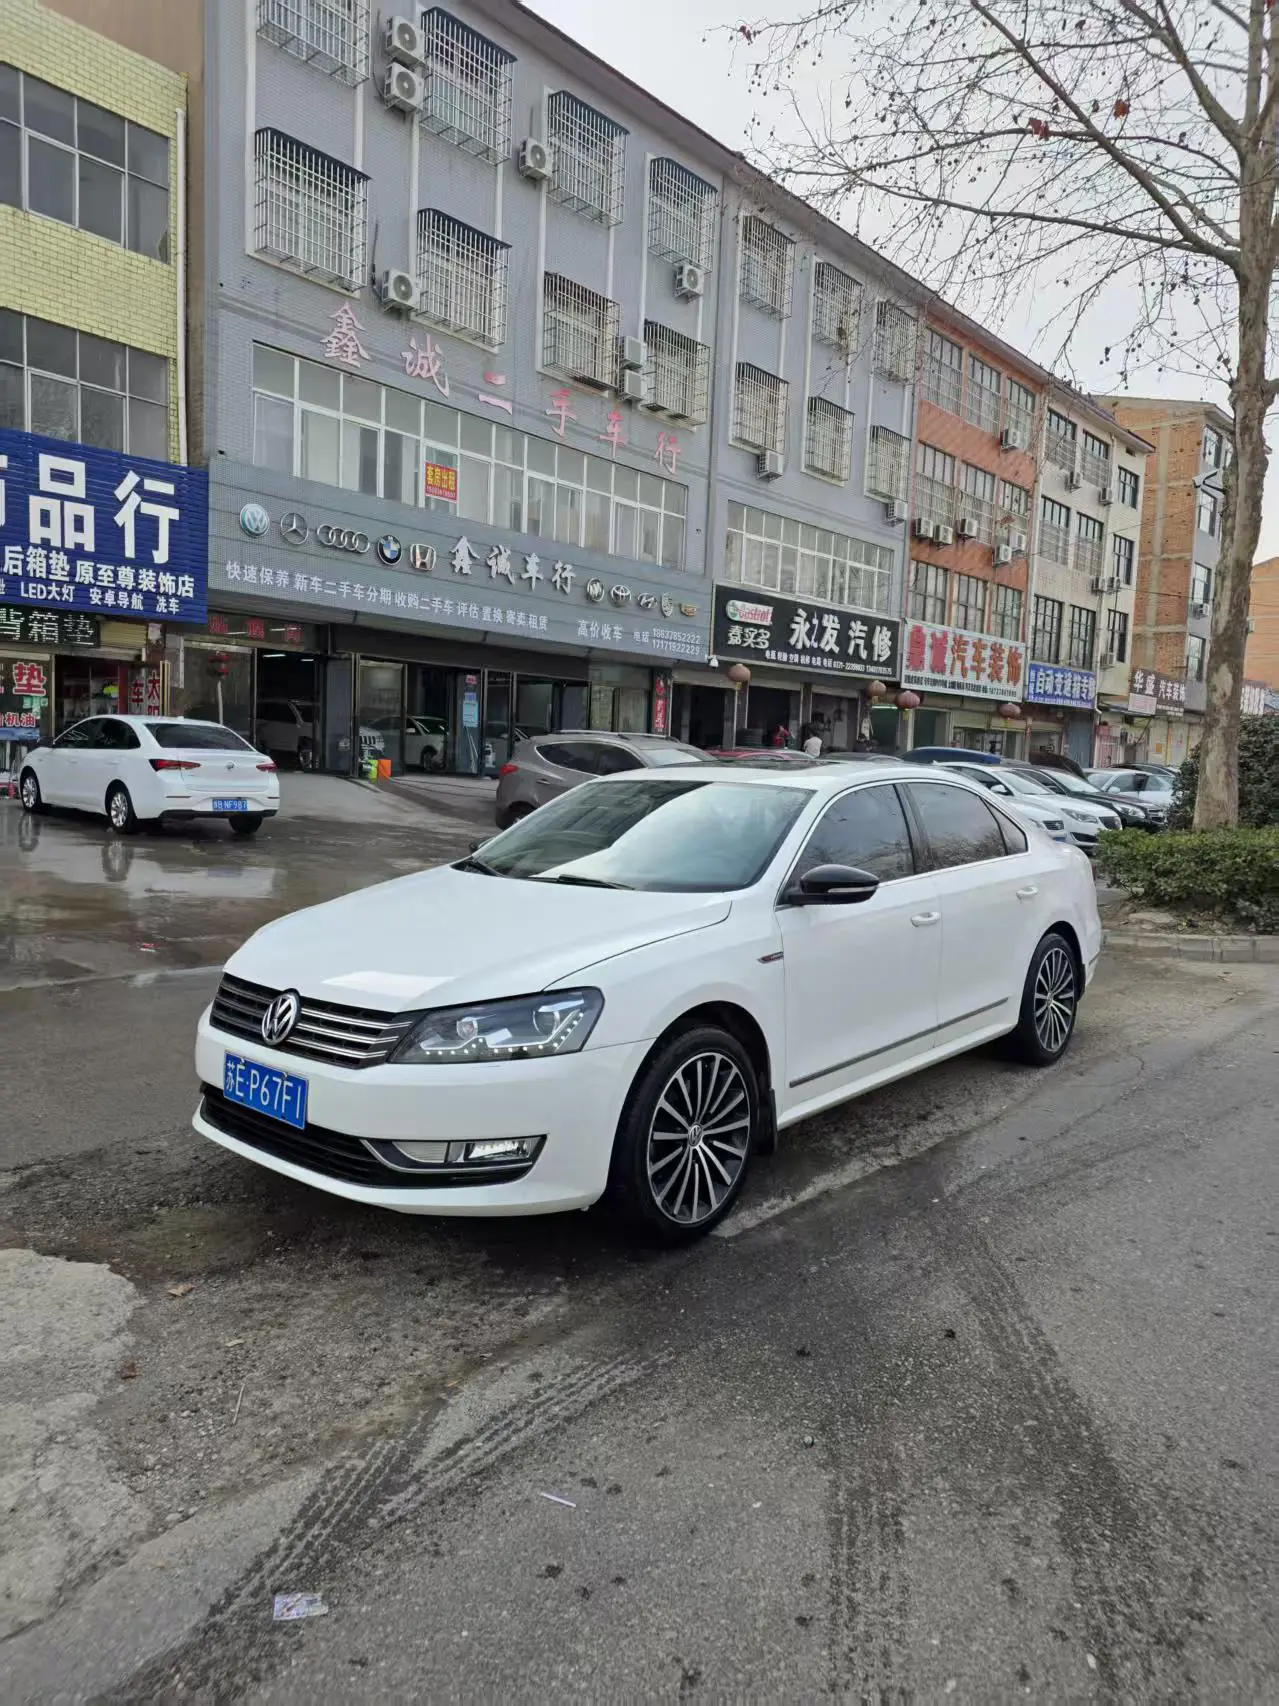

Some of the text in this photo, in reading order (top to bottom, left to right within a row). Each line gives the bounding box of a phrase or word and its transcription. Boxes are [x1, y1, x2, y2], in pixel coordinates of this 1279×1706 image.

[320, 301, 682, 476] 鑫诚二手车行
[75, 560, 194, 598] 原至尊装饰店
[450, 536, 577, 594] 鑫诚车行
[20, 581, 75, 603] LED大灯
[89, 588, 144, 611] 安卓导航
[156, 597, 180, 615] 洗车
[226, 561, 290, 589] 快速保养
[294, 573, 392, 606] 新车二手车分期
[395, 592, 454, 615] 收购二手车
[457, 602, 479, 619] 评估
[528, 614, 549, 631] 租赁
[577, 619, 623, 642] 高价收车
[727, 625, 771, 649] 嘉实多
[788, 608, 893, 663] 永发汽修
[0, 711, 36, 728] 机油
